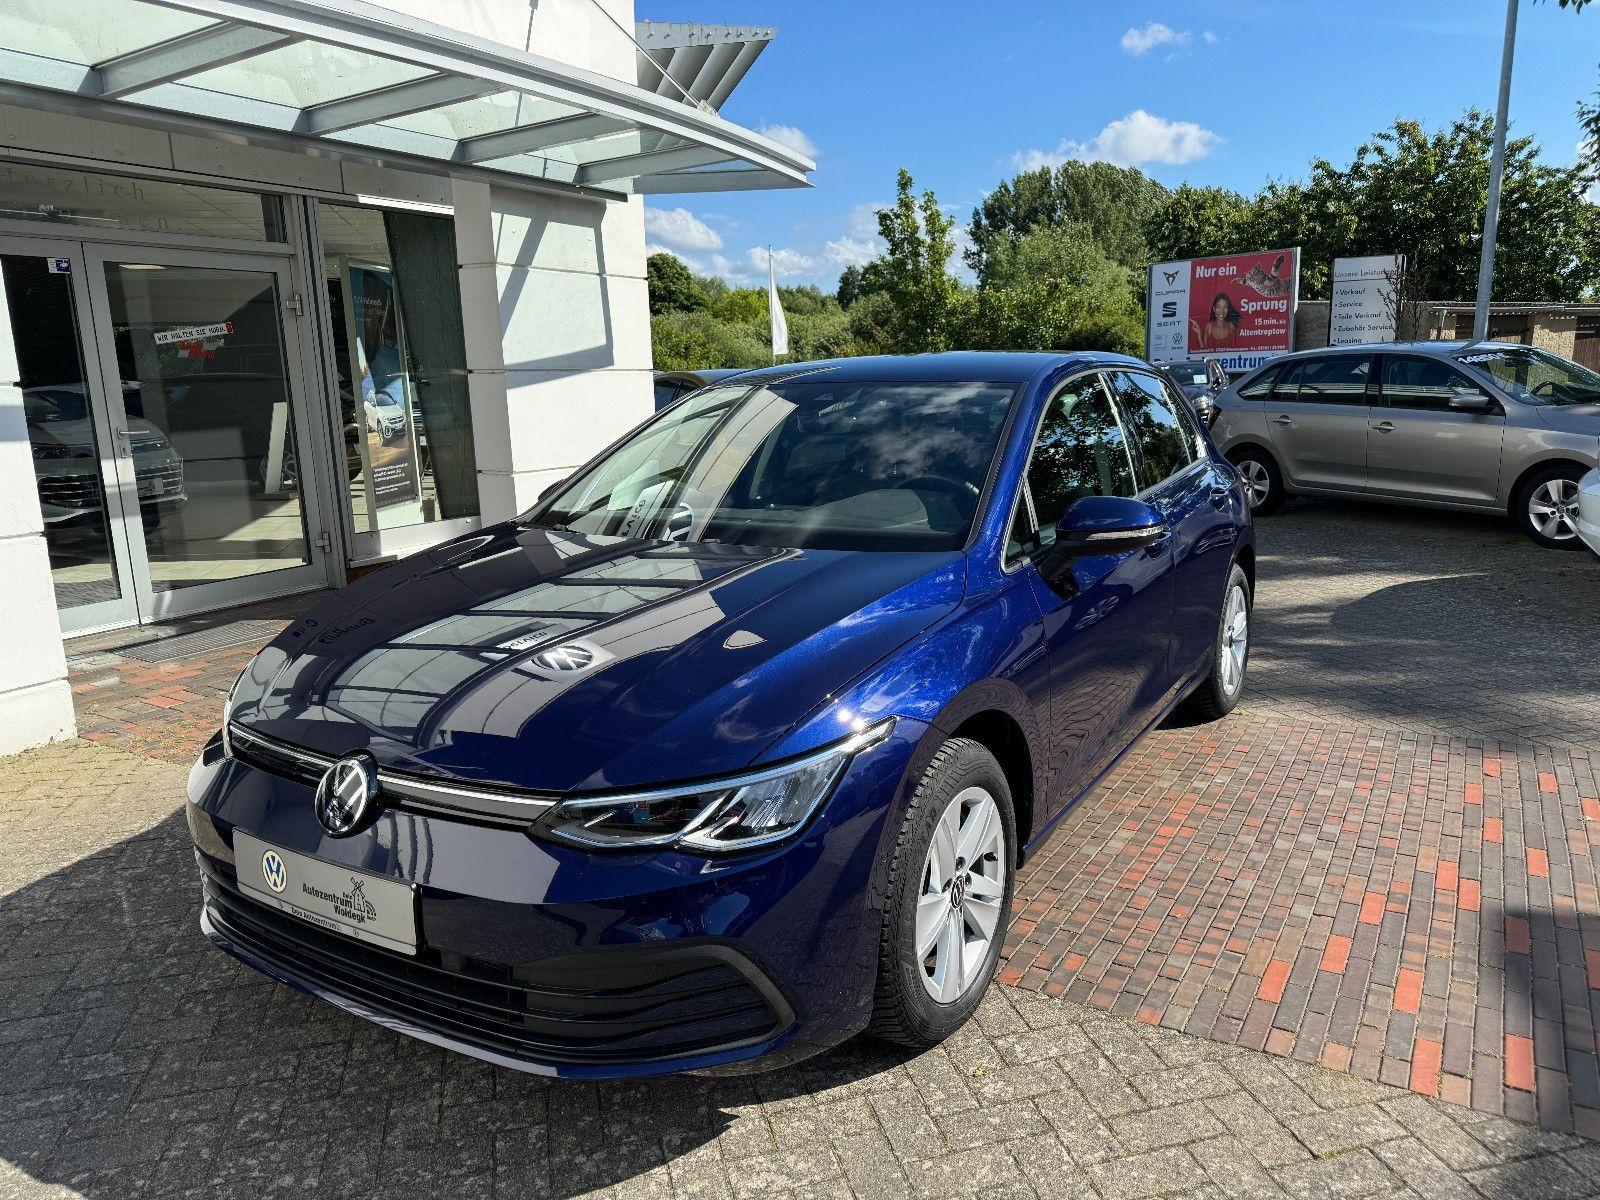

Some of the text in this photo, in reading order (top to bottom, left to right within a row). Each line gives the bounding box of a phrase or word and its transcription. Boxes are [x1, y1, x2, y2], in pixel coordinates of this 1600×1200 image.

[1196, 263, 1237, 278] Nur ein
[1339, 288, 1366, 296] Verkauf
[1240, 299, 1287, 314] Sprung
[1337, 311, 1381, 320] Teile Verkauf
[1156, 320, 1182, 328] SEAT
[1254, 318, 1263, 326] 15
[1263, 317, 1279, 325] min.
[1239, 328, 1286, 337] Altentreptow
[302, 882, 353, 910] Autozentrum
[333, 904, 366, 924] Woldegk
